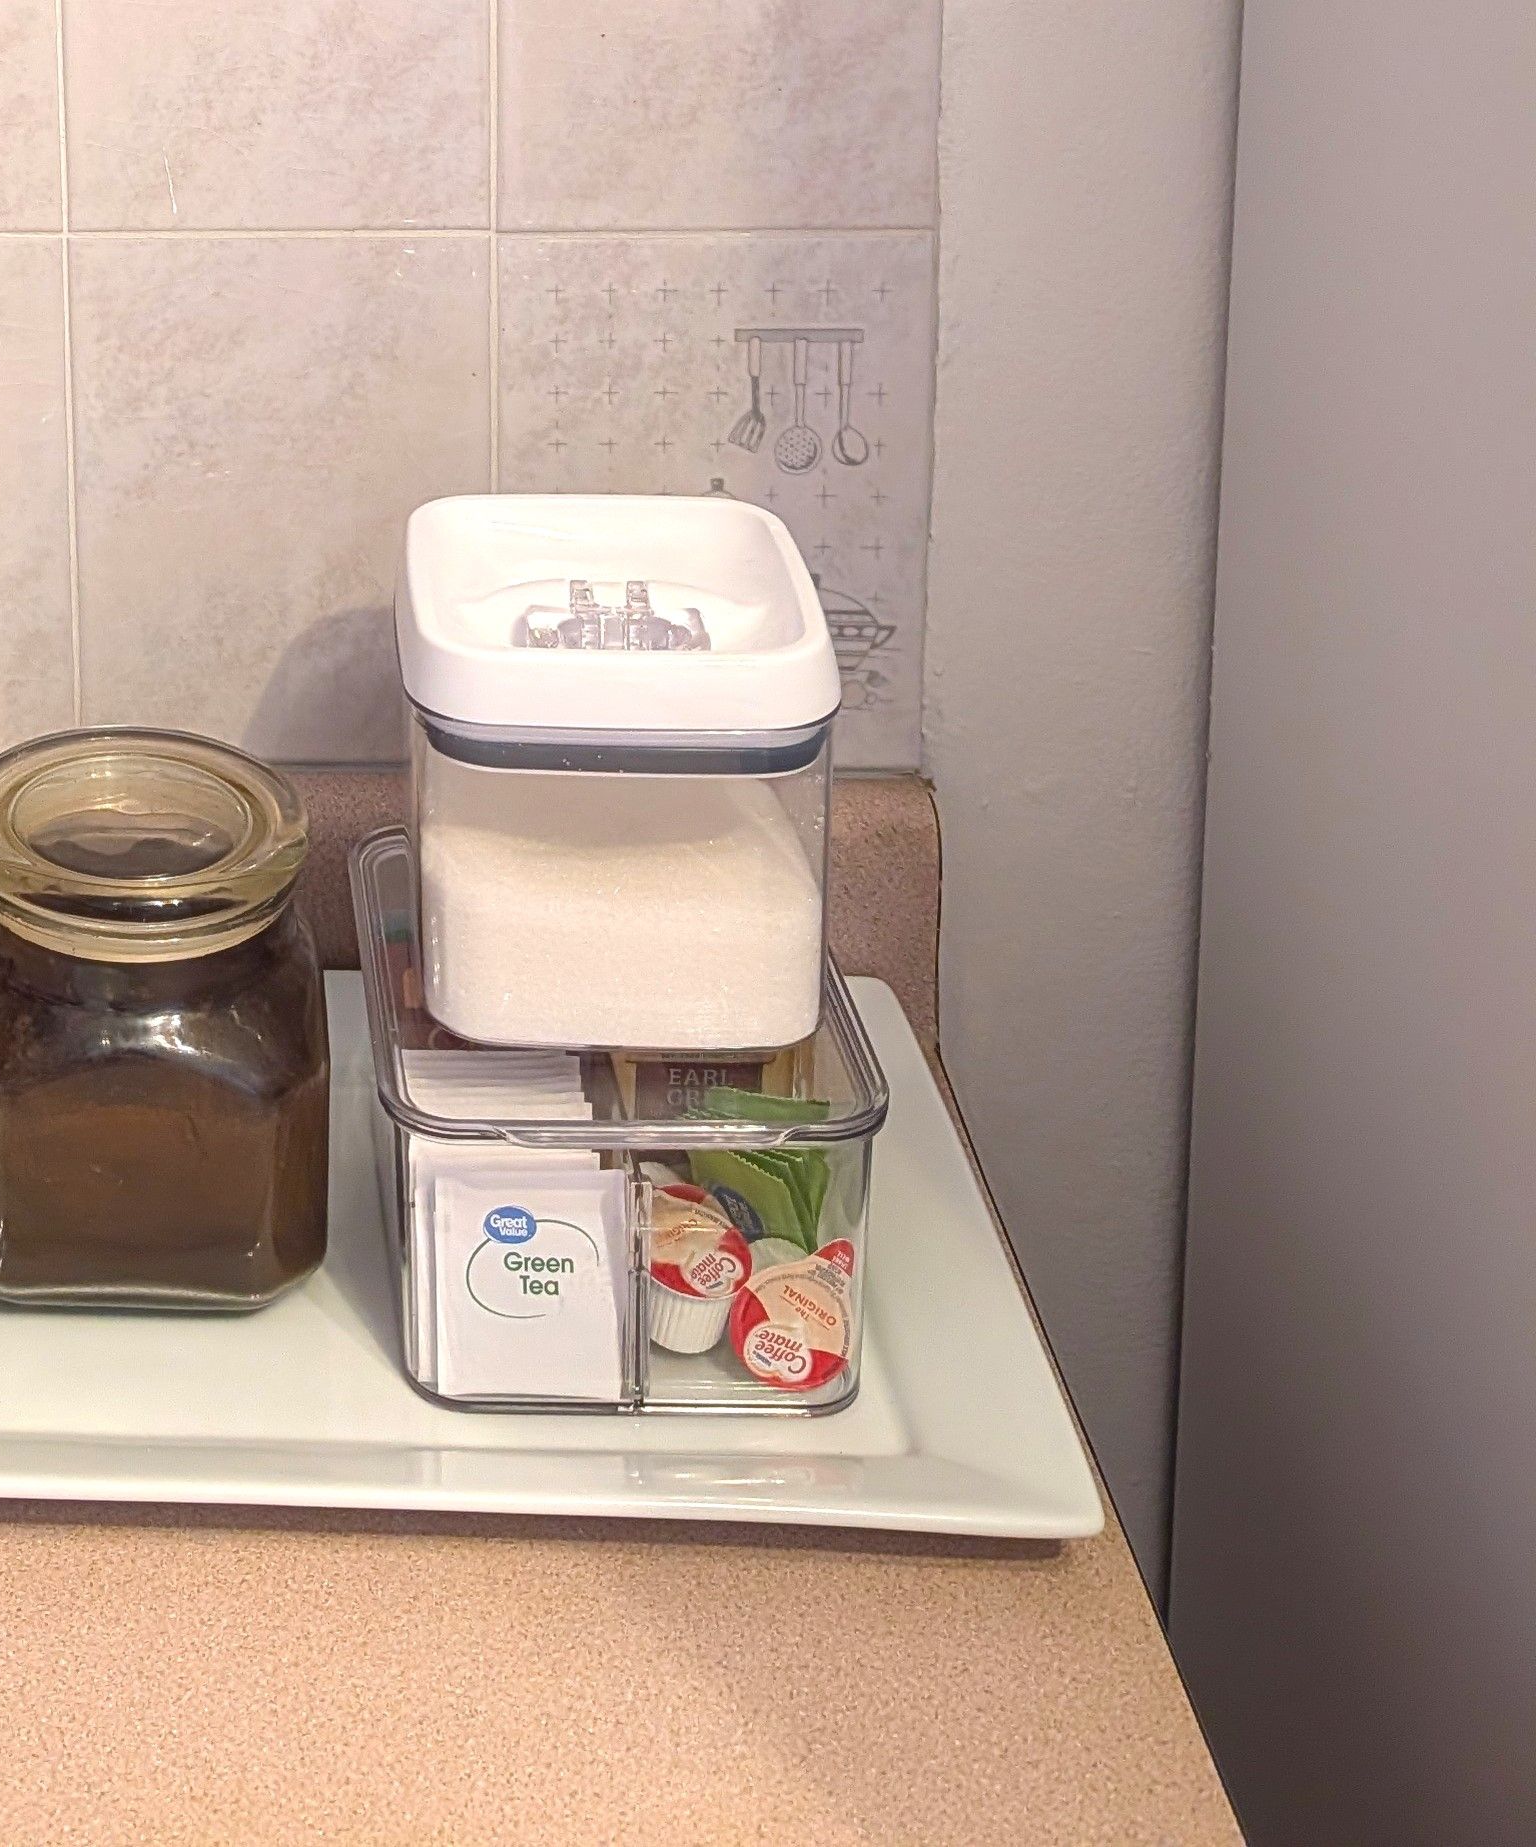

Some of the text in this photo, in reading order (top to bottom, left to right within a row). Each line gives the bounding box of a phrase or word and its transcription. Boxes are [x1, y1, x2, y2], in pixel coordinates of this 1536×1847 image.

[668, 1068, 734, 1086] EARL
[667, 1088, 703, 1105] GR
[490, 1214, 527, 1229] Great
[499, 1227, 527, 1237] Value
[503, 1251, 574, 1273] Green
[690, 1252, 717, 1279] mate
[698, 1257, 737, 1285] Coffee
[519, 1274, 559, 1295] Tea
[783, 1284, 837, 1326] ORIGINAL
[795, 1306, 811, 1321] The
[760, 1329, 803, 1351] mate
[754, 1339, 807, 1375] Coffee
